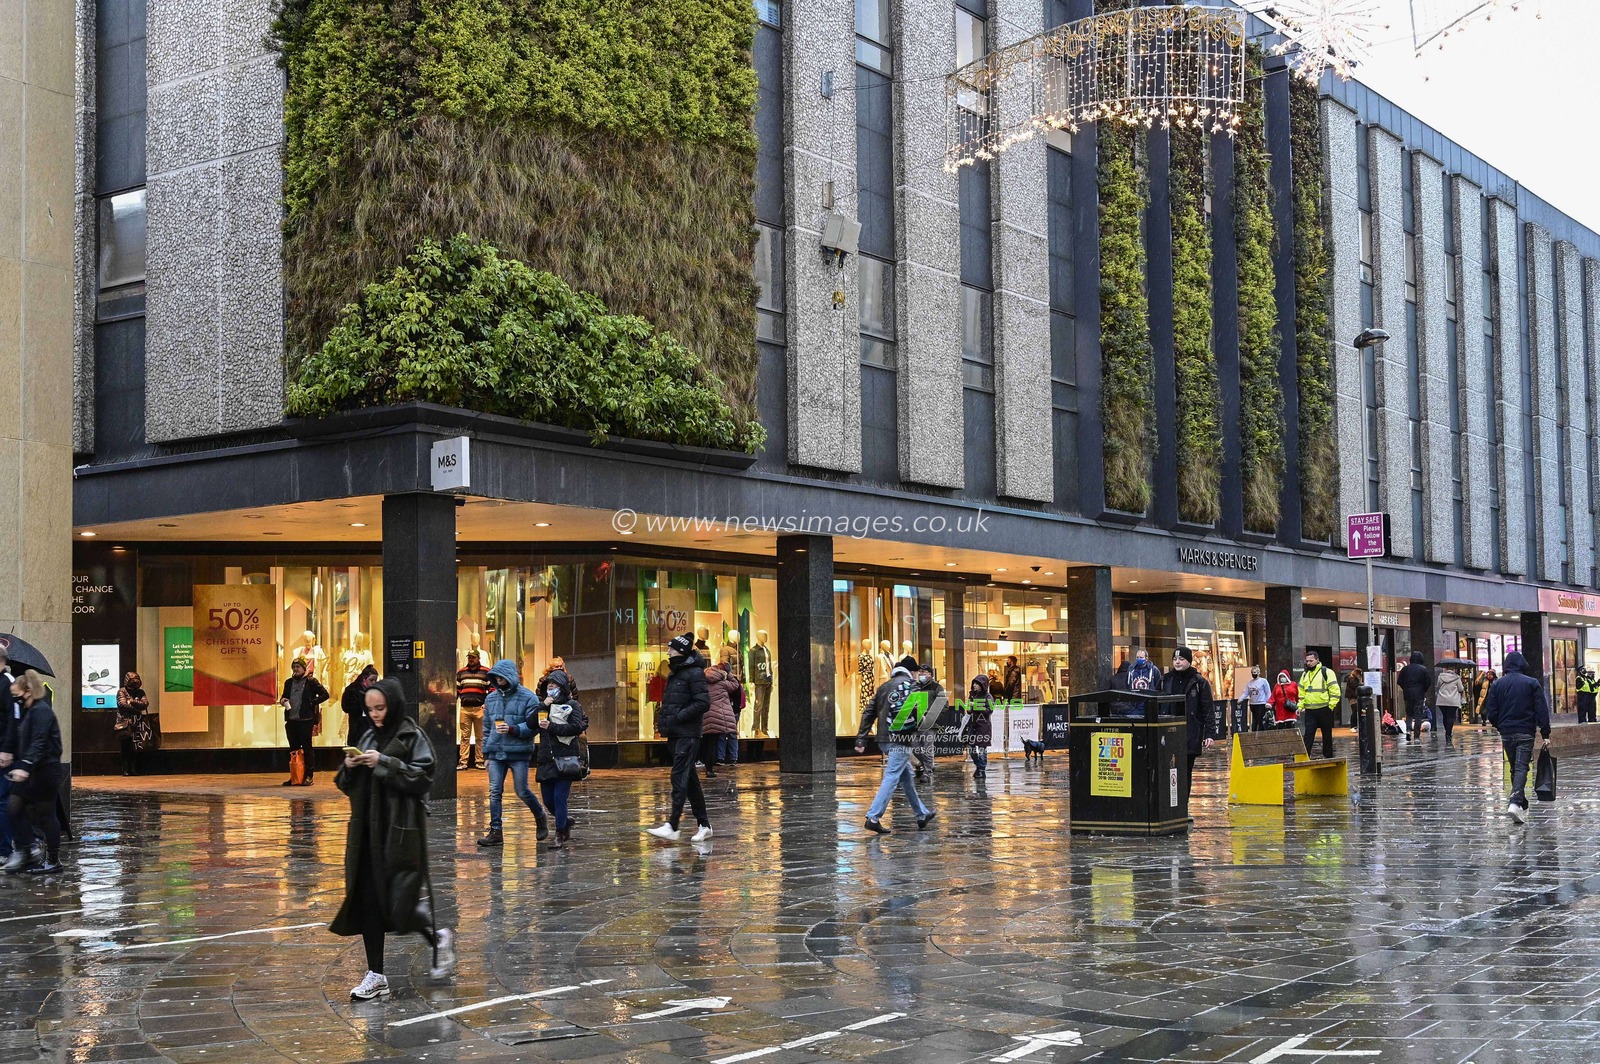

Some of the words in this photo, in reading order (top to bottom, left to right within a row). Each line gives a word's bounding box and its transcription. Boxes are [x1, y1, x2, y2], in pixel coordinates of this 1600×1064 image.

[438, 453, 457, 468] M&S
[208, 608, 259, 631] 50%
[205, 638, 262, 646] CHRISTMAS
[220, 647, 248, 655] GIFTS
[414, 642, 424, 657] H
[1013, 719, 1034, 729] FRESH
[1047, 722, 1069, 731] MARKE
[1098, 737, 1124, 746] STREET
[1098, 746, 1124, 758] ZERO
